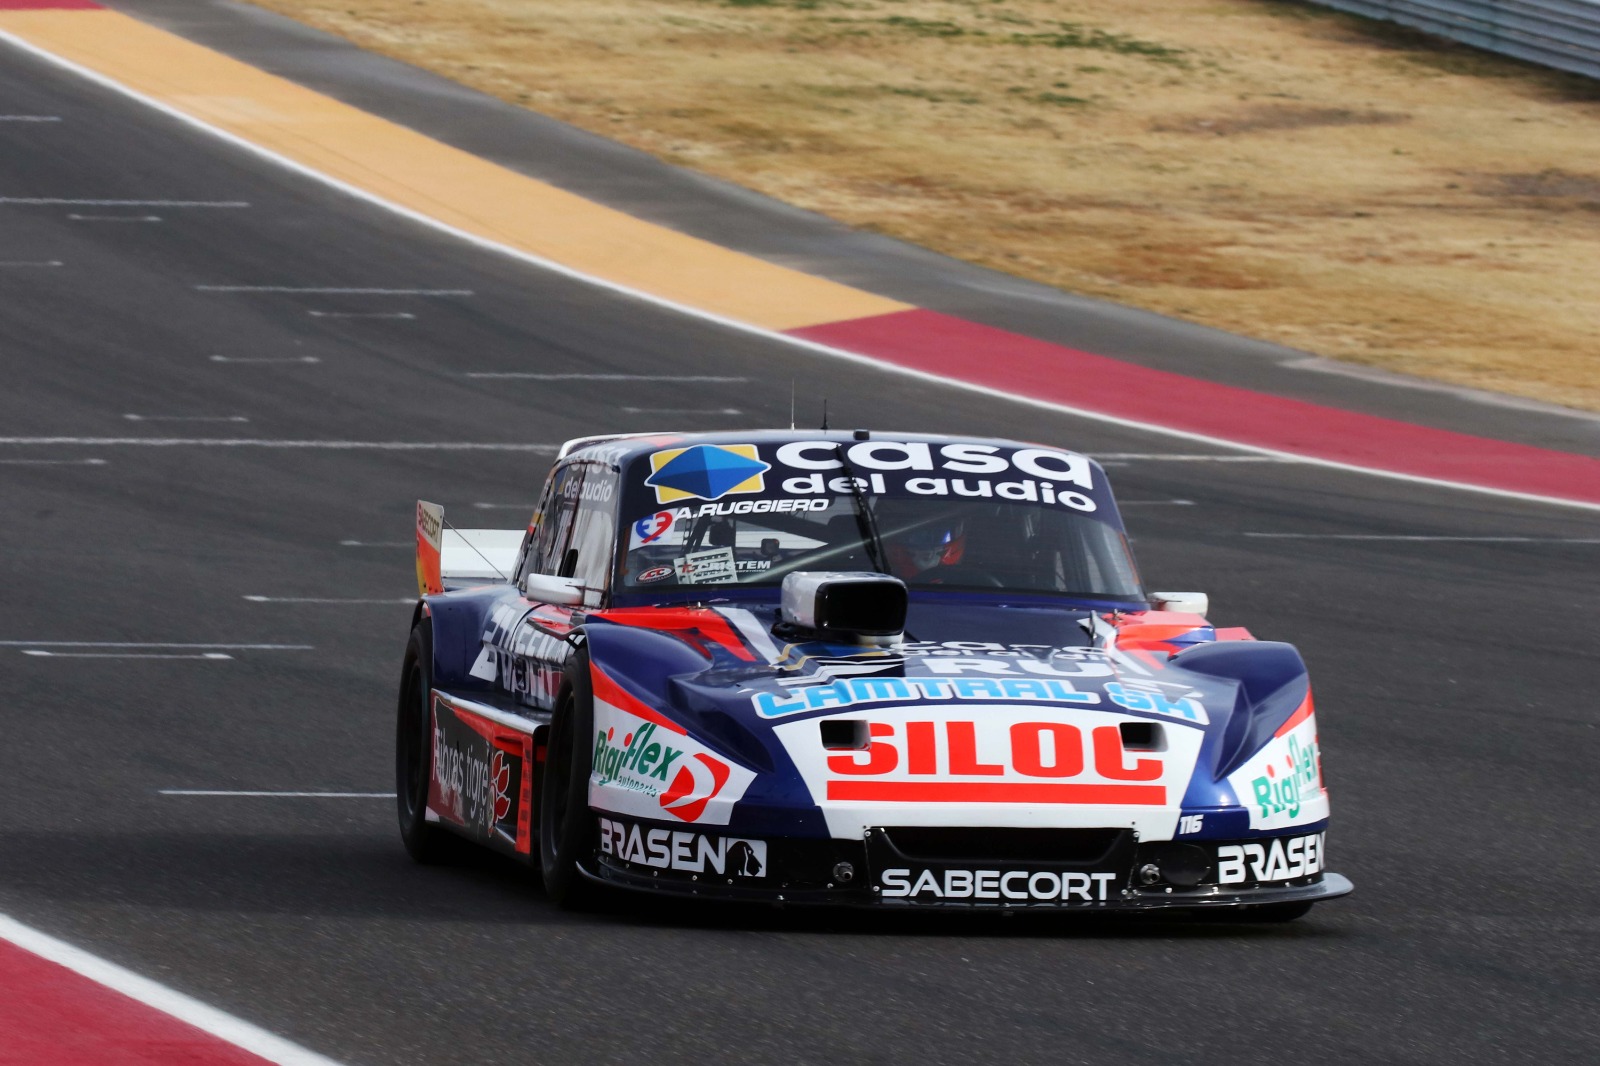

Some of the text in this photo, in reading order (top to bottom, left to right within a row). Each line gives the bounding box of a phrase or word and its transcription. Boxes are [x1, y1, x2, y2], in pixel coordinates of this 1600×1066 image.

[776, 441, 1094, 491] casa
[674, 498, 830, 521] A.RUGGIERO
[781, 473, 1098, 513] del audio
[1179, 814, 1204, 835] 116
[599, 817, 726, 875] BRASEN
[881, 868, 1116, 902] SABECORT
